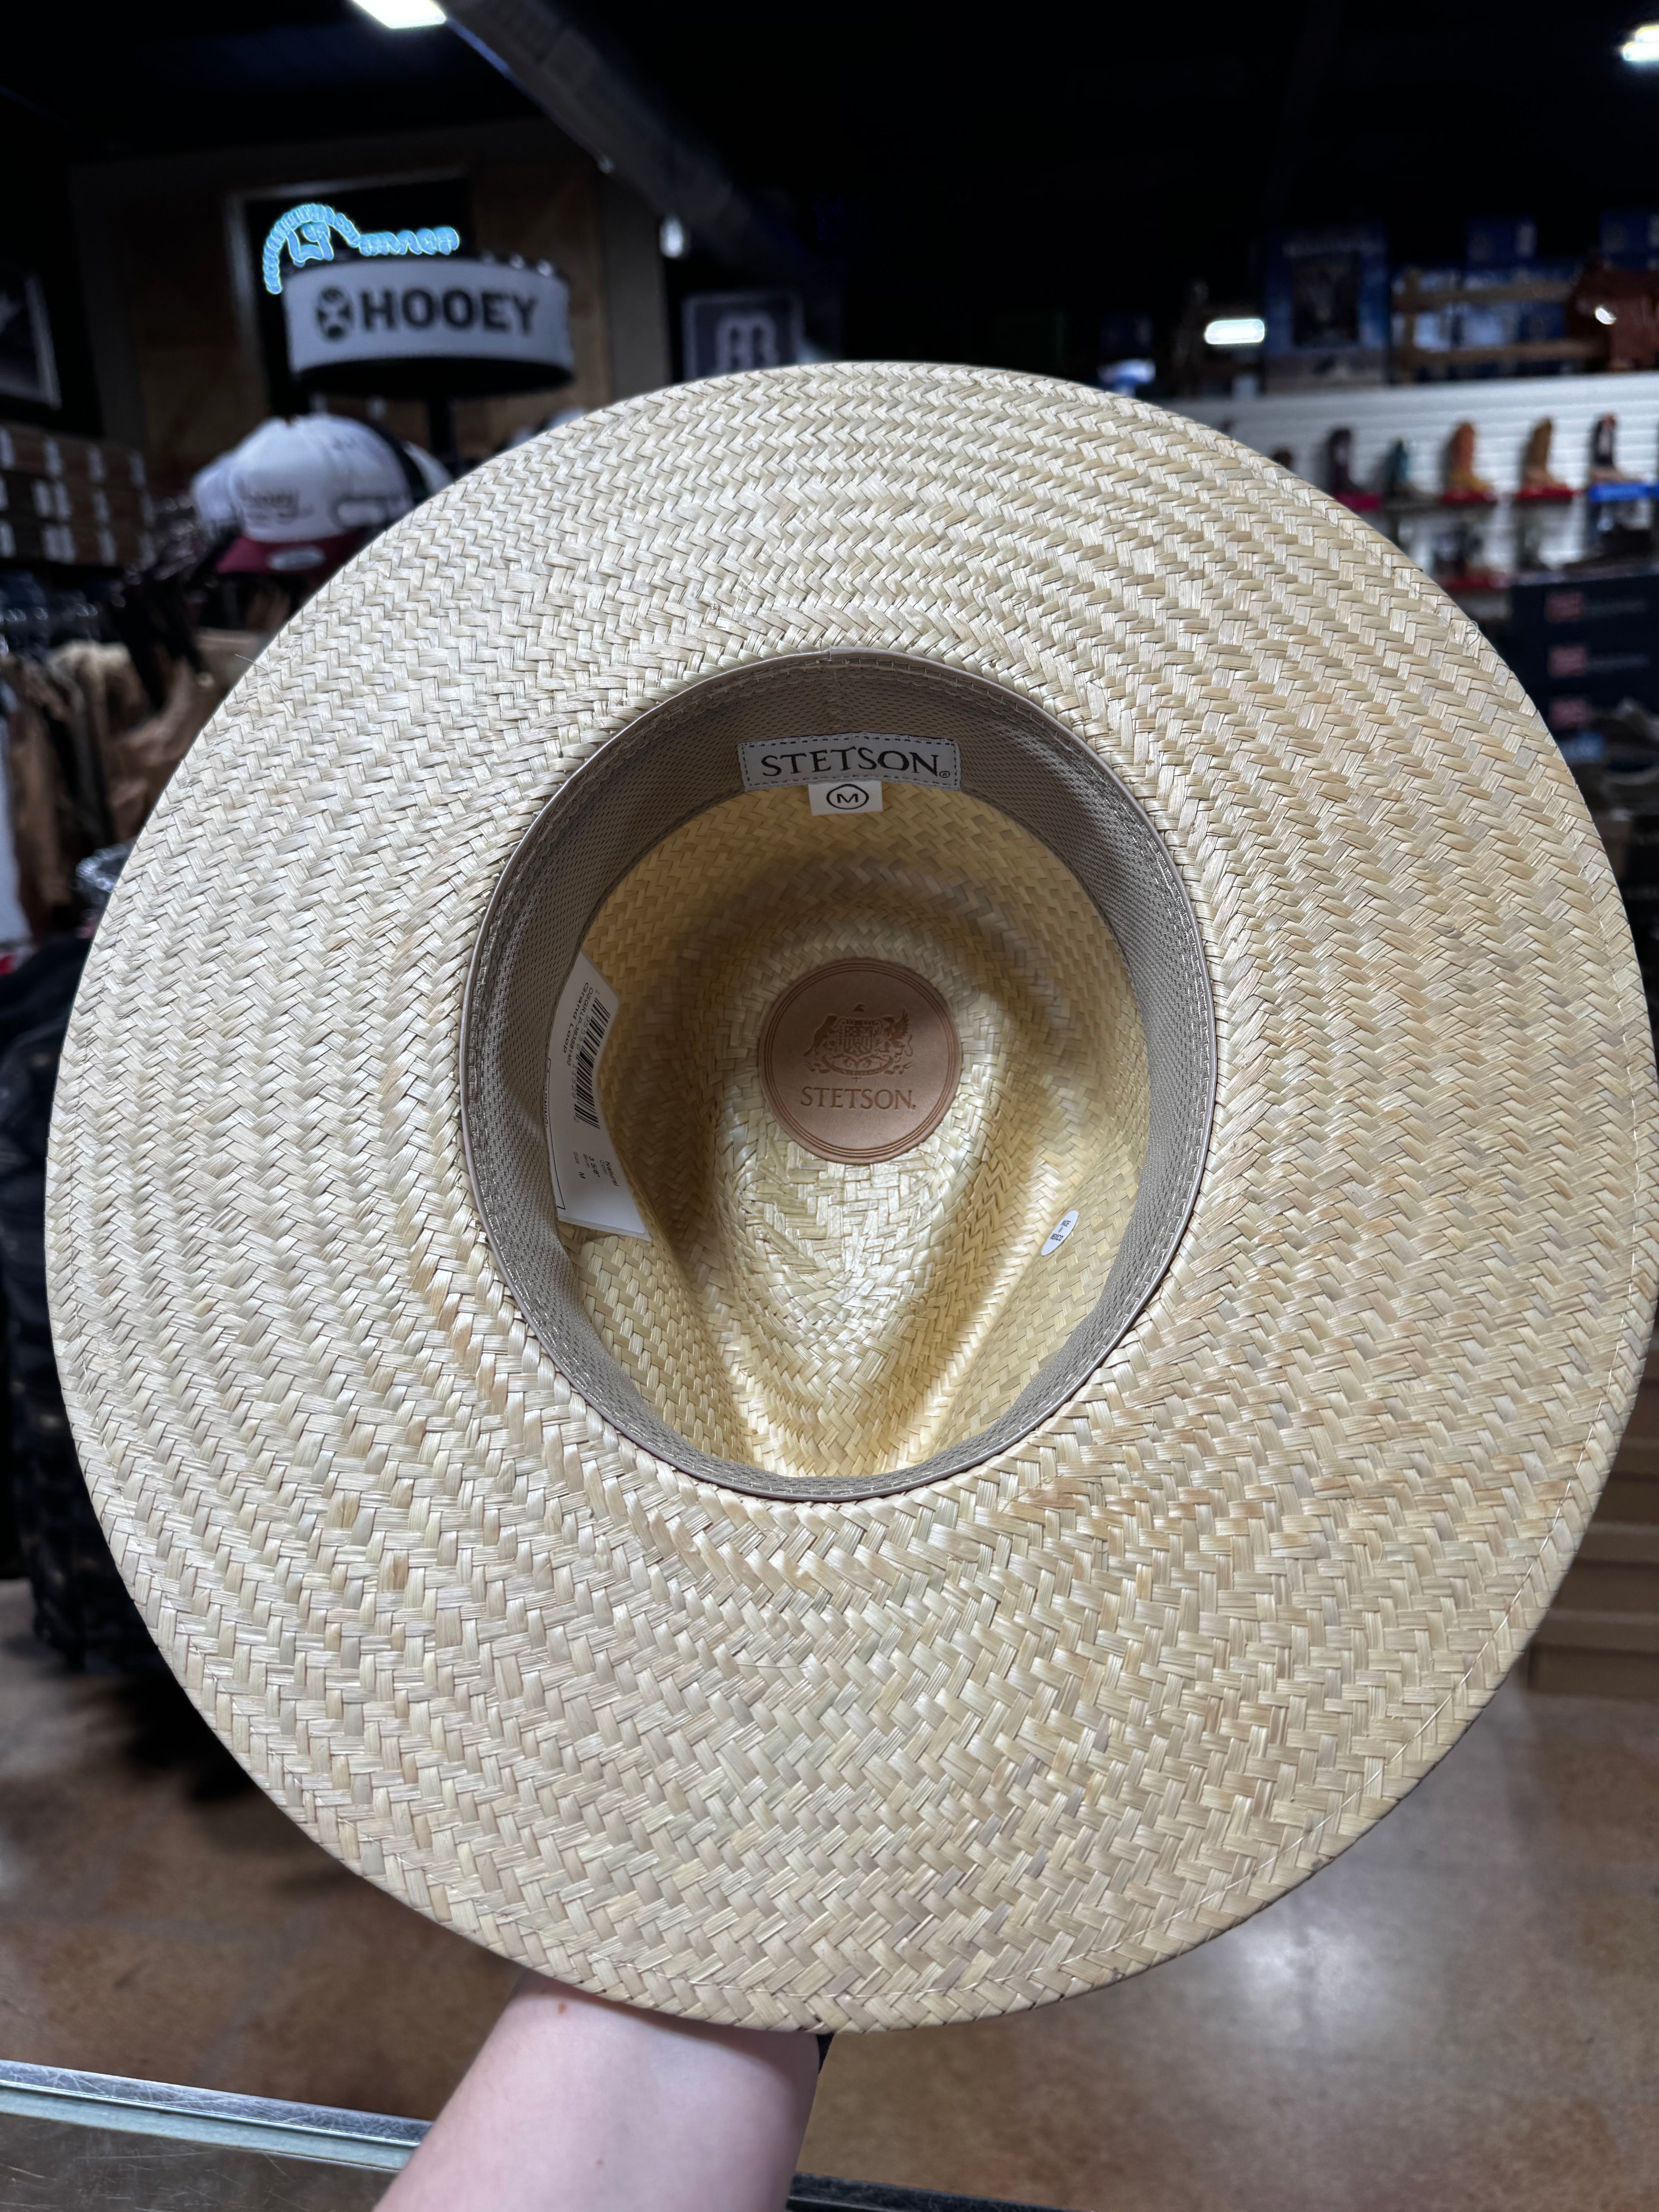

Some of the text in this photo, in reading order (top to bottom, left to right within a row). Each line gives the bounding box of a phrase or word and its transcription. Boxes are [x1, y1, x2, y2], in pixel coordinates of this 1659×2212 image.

[362, 289, 537, 334] HOOEY
[761, 746, 939, 777] STETSON
[837, 793, 859, 804] M
[564, 982, 588, 1053] Grand Loop
[801, 1086, 912, 1110] STETSON
[605, 1161, 620, 1187] Natural
